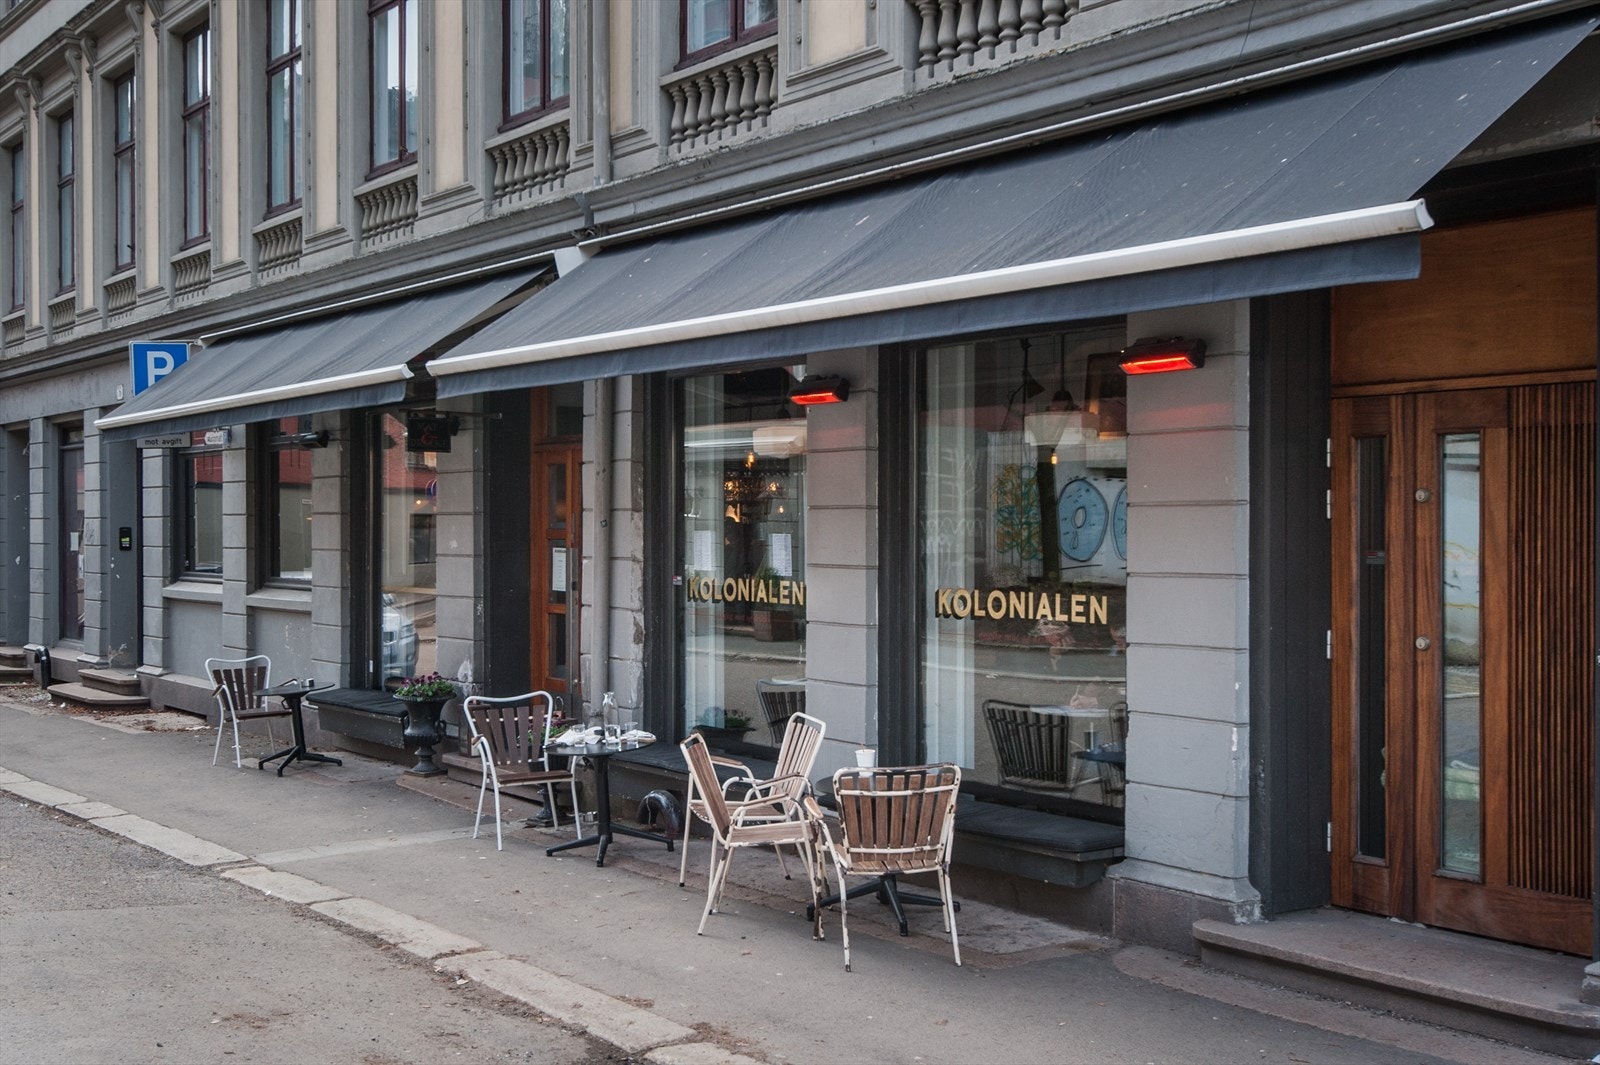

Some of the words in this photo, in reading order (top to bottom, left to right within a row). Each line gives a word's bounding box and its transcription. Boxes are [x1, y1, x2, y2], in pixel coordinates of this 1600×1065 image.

[147, 351, 174, 387] P
[162, 438, 182, 446] avgift
[688, 576, 805, 606] KOLONIALEN
[936, 588, 1108, 625] KOLONIALEN
